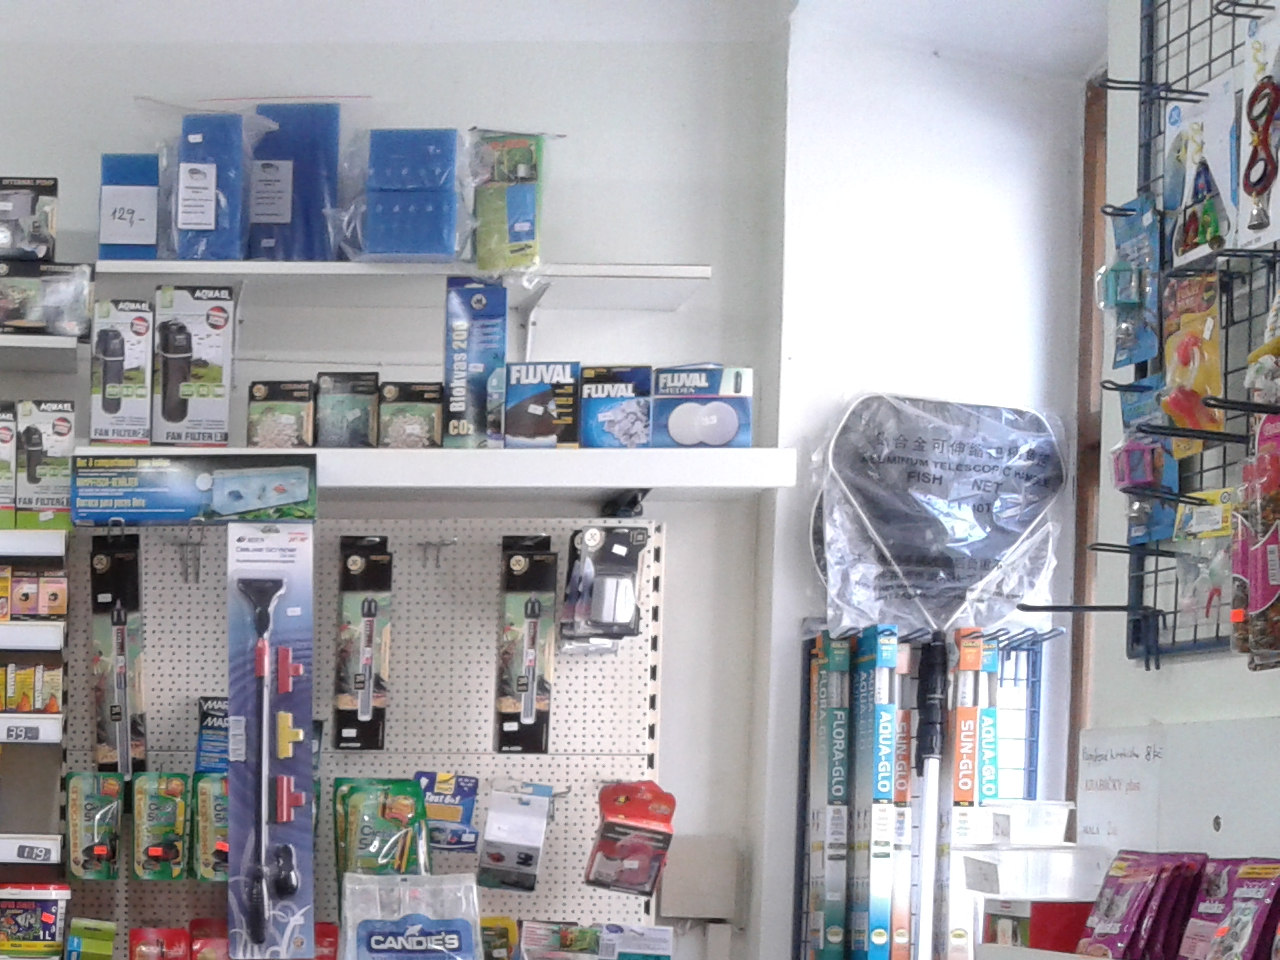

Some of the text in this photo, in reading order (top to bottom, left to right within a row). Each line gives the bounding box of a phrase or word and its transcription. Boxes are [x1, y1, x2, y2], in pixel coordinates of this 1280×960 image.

[509, 364, 574, 385] FLUVAL
[658, 372, 709, 388] FLUVAL
[582, 383, 636, 398] FLUVAL
[907, 471, 1004, 496] FISH NET
[831, 710, 846, 797] FLORA-GLO
[877, 711, 893, 793] AQUA-GLO
[958, 719, 975, 791] SUN-GLO
[981, 715, 997, 796] AQUA-GLO
[370, 933, 459, 950] CANDIE'S
